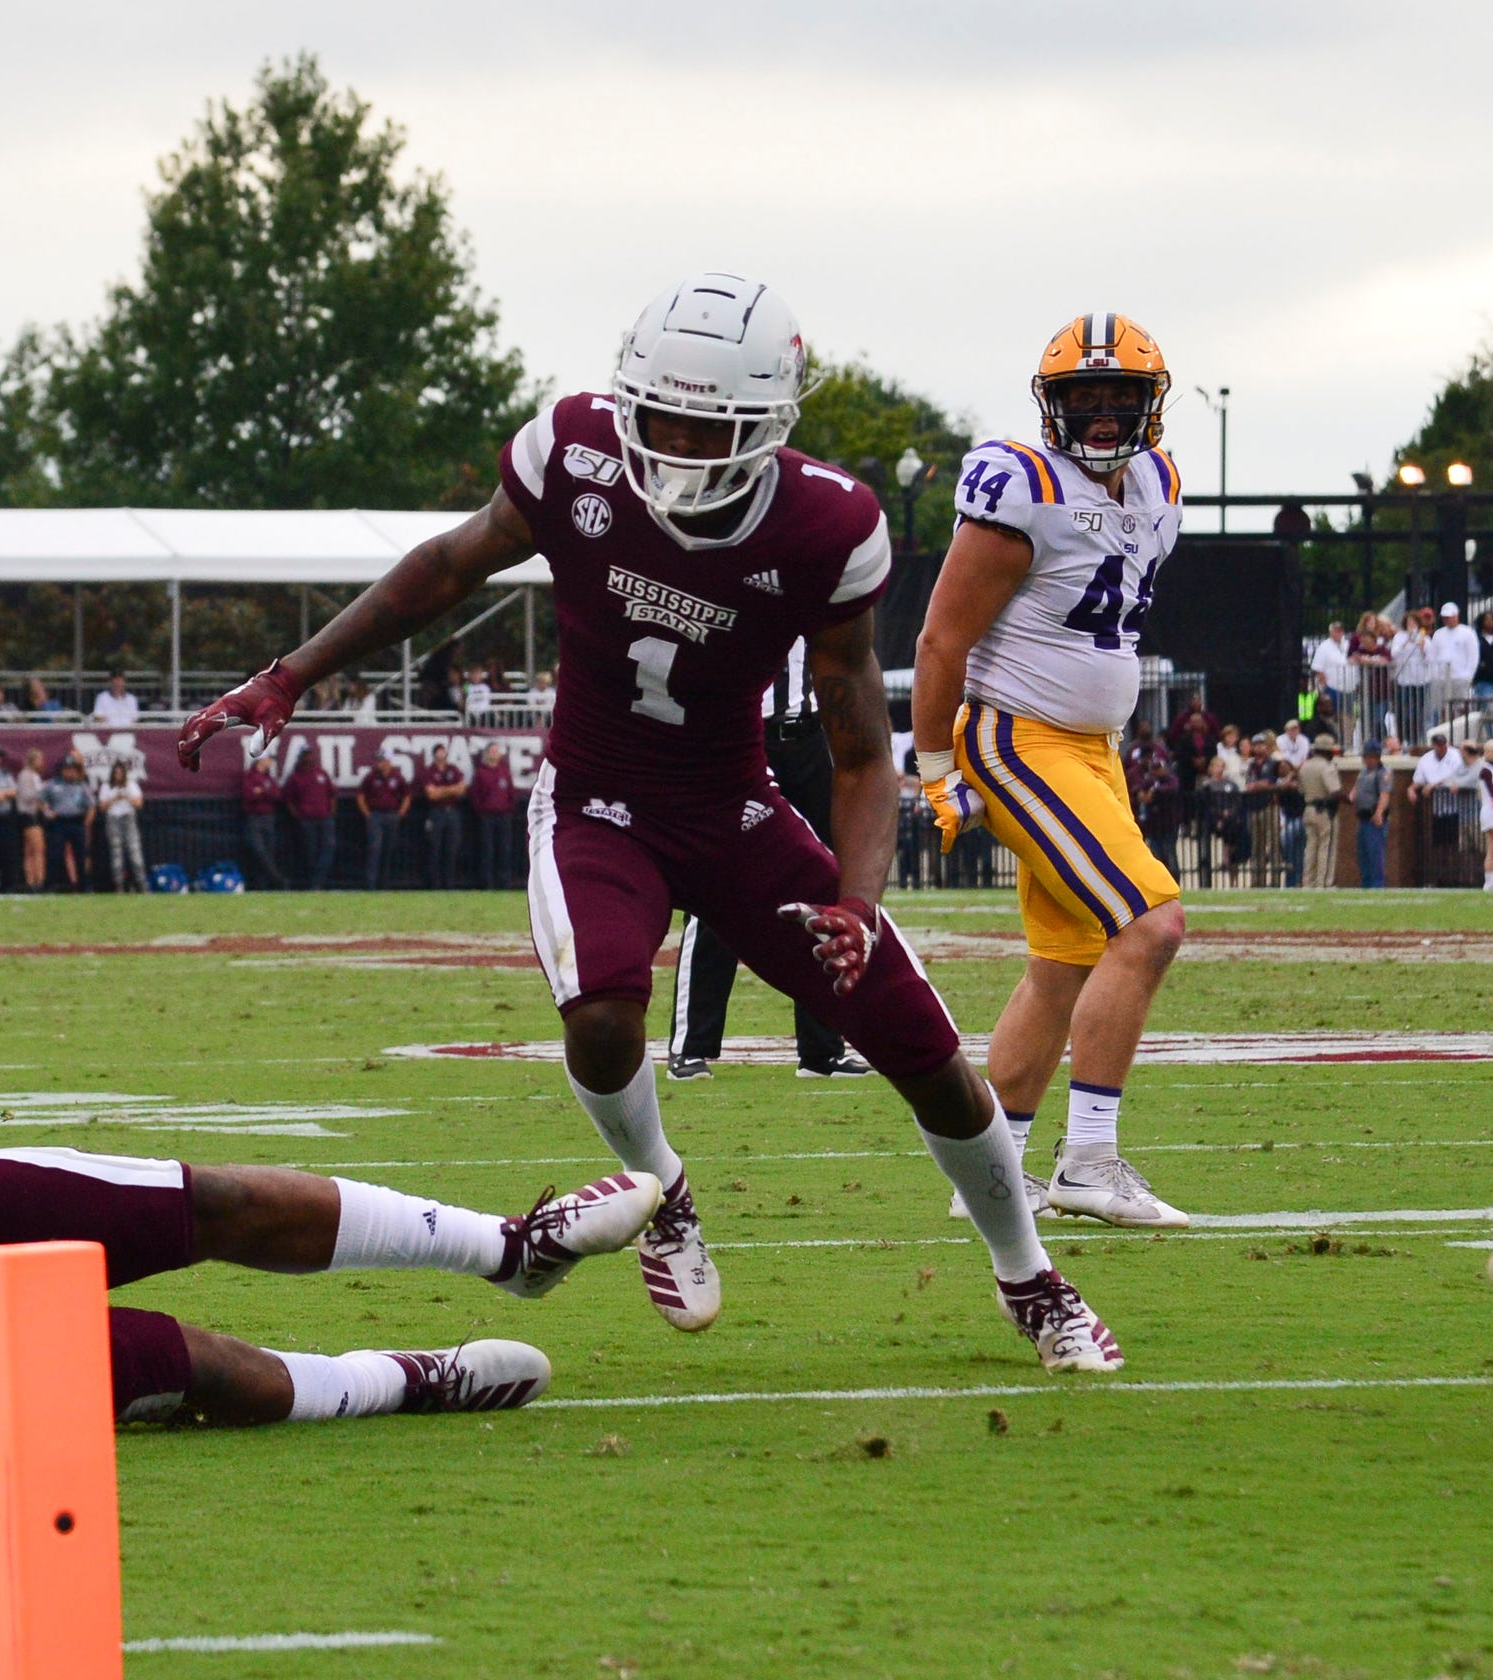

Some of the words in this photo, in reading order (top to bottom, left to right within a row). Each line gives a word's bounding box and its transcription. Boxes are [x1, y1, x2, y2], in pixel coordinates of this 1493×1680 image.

[1086, 358, 1109, 368] LSU
[673, 379, 706, 393] STATE
[563, 442, 625, 486] 150
[800, 463, 855, 492] 1
[962, 460, 1012, 513] 44
[574, 496, 609, 534] SEC
[1072, 511, 1103, 532] 150
[1118, 542, 1139, 555] SU
[608, 569, 738, 628] MISSISSIPPI
[638, 606, 694, 638] STATE
[627, 636, 685, 726] 1
